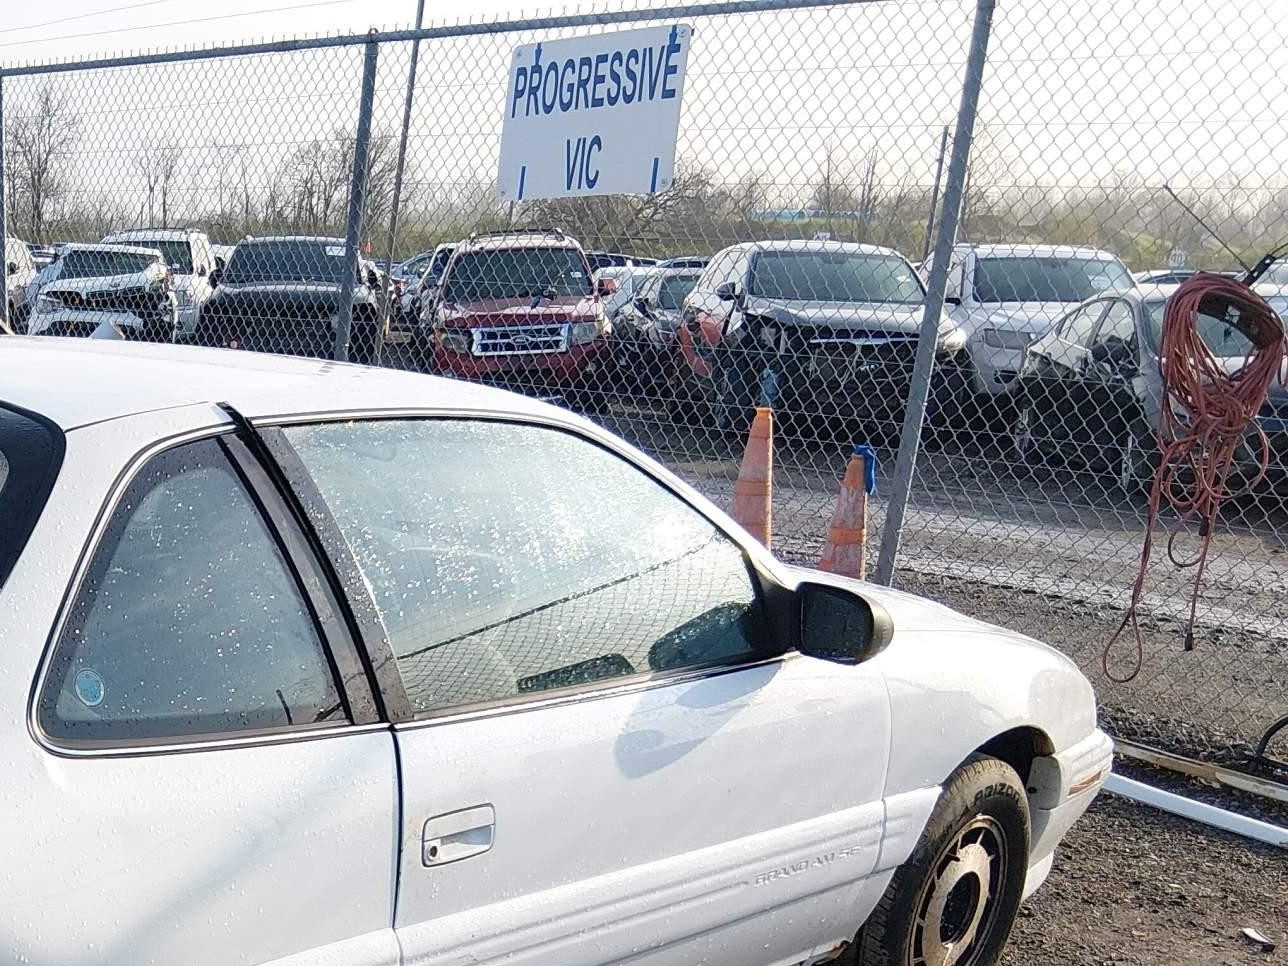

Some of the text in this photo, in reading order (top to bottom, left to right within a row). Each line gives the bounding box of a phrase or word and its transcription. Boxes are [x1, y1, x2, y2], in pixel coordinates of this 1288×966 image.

[512, 42, 681, 119] PROGRESSIVE
[566, 134, 602, 191] VIC
[753, 860, 809, 888] GRAND
